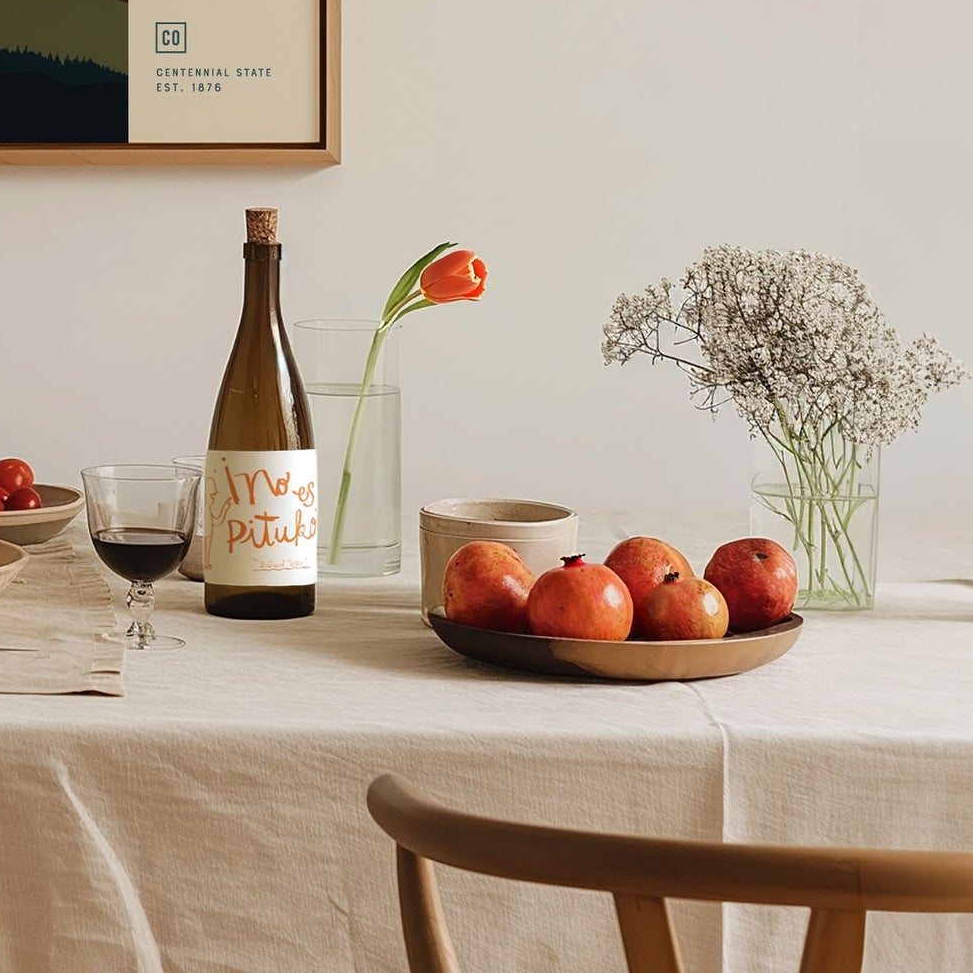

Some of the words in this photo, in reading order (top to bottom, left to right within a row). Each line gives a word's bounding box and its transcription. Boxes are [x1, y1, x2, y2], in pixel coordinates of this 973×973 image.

[162, 29, 180, 46] CO
[156, 67, 230, 77] CENTENNIAL
[236, 67, 272, 77] STATE
[156, 82, 184, 92] EST.
[191, 82, 222, 92] 1876
[292, 481, 315, 507] es
